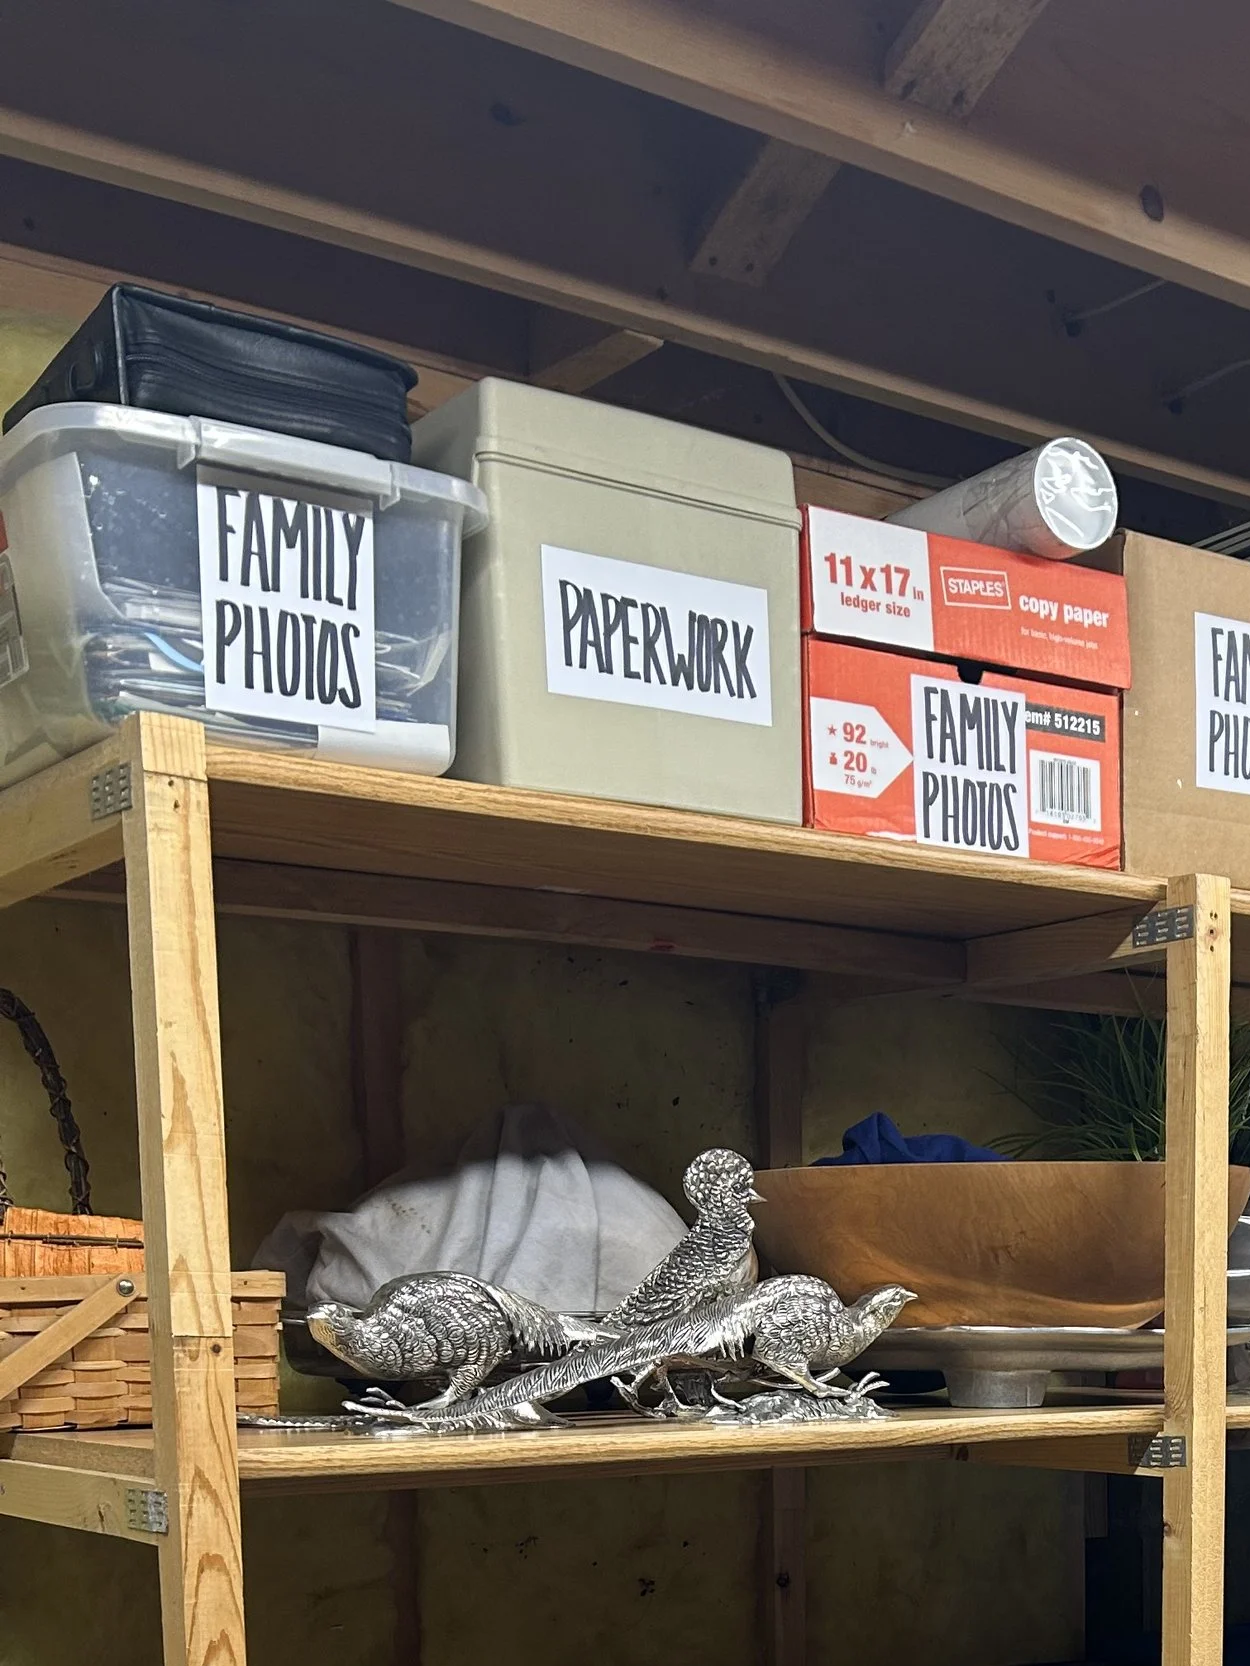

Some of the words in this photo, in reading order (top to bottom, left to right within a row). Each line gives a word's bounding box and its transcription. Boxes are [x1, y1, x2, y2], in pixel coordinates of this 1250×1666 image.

[216, 484, 366, 611] FAMILY
[948, 577, 1004, 598] STAPLES
[840, 591, 881, 614] ledger
[885, 600, 911, 618] size
[1018, 594, 1058, 622] copy
[1064, 604, 1109, 629] paper
[214, 600, 362, 709] PHOTOS
[558, 579, 757, 699] PAPERWORK
[842, 722, 867, 745] 92
[924, 686, 1018, 775] FAMILY
[1025, 710, 1051, 727] em#
[1054, 713, 1101, 736] 512215
[843, 750, 868, 773] 20
[844, 774, 856, 786] 75
[922, 771, 1020, 851] PHOTOS
